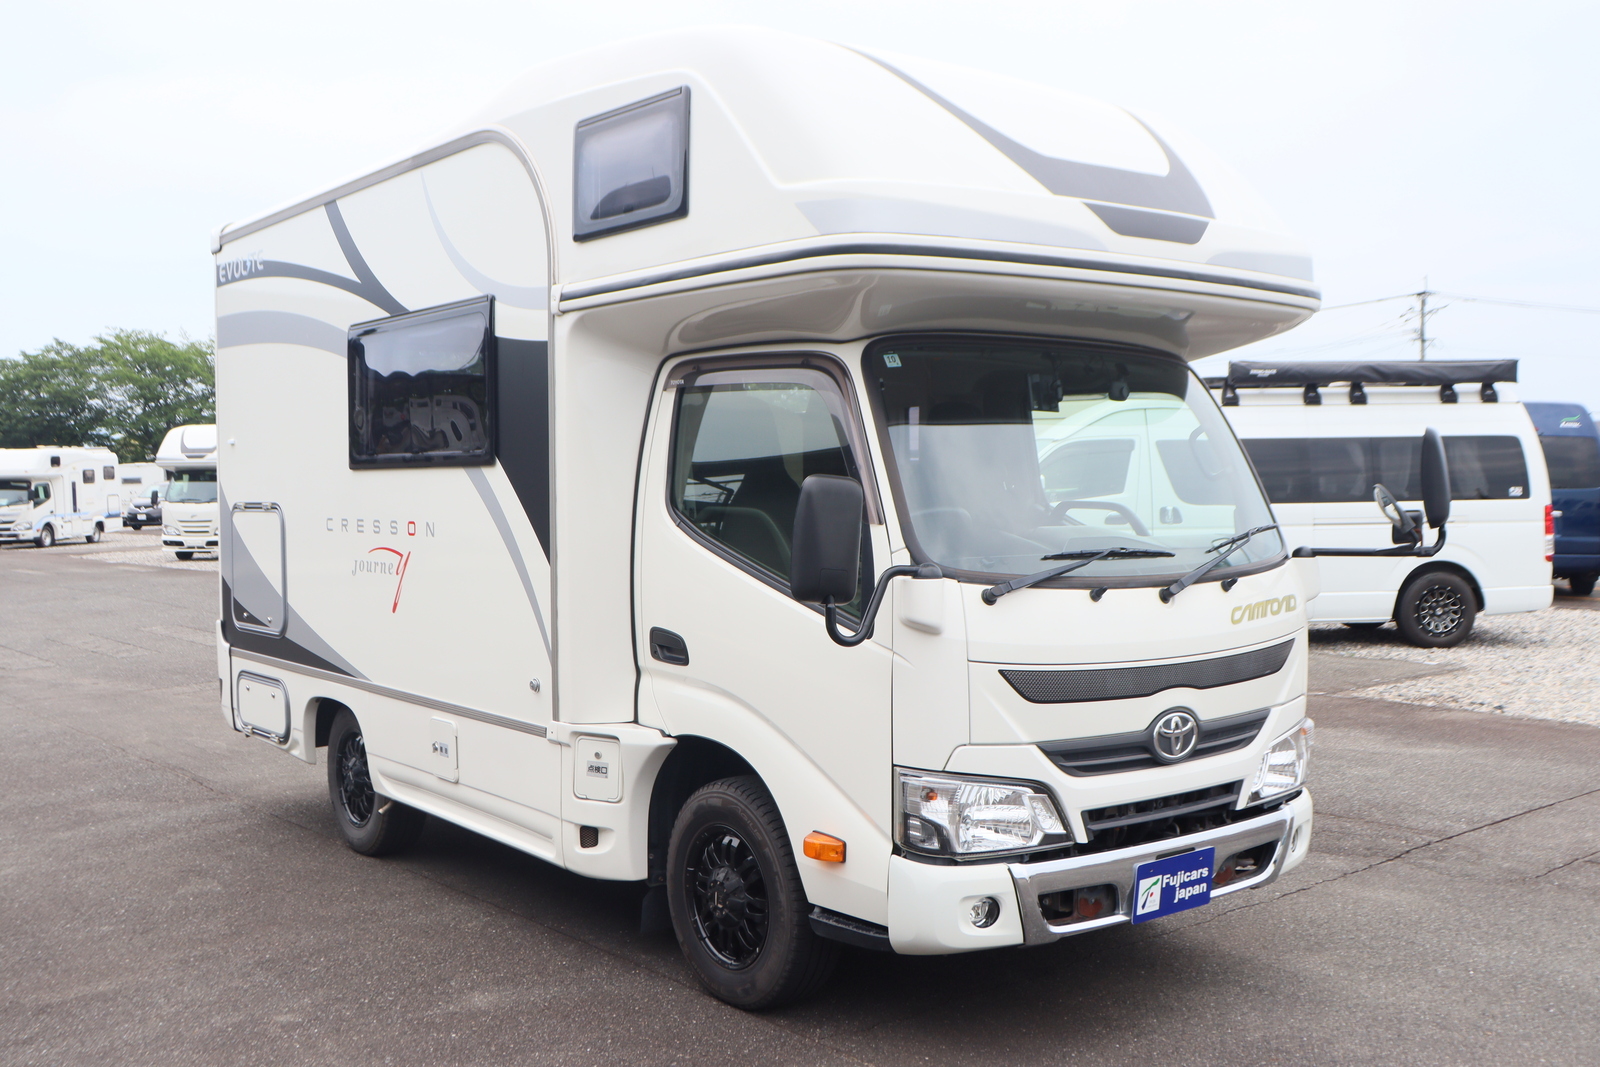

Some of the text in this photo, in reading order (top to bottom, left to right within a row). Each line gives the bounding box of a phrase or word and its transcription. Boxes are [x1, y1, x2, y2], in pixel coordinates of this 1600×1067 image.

[326, 517, 435, 537] CRESSON
[587, 764, 608, 775] 点検口
[1162, 867, 1209, 888] Fujicars
[1173, 882, 1207, 903] japan
